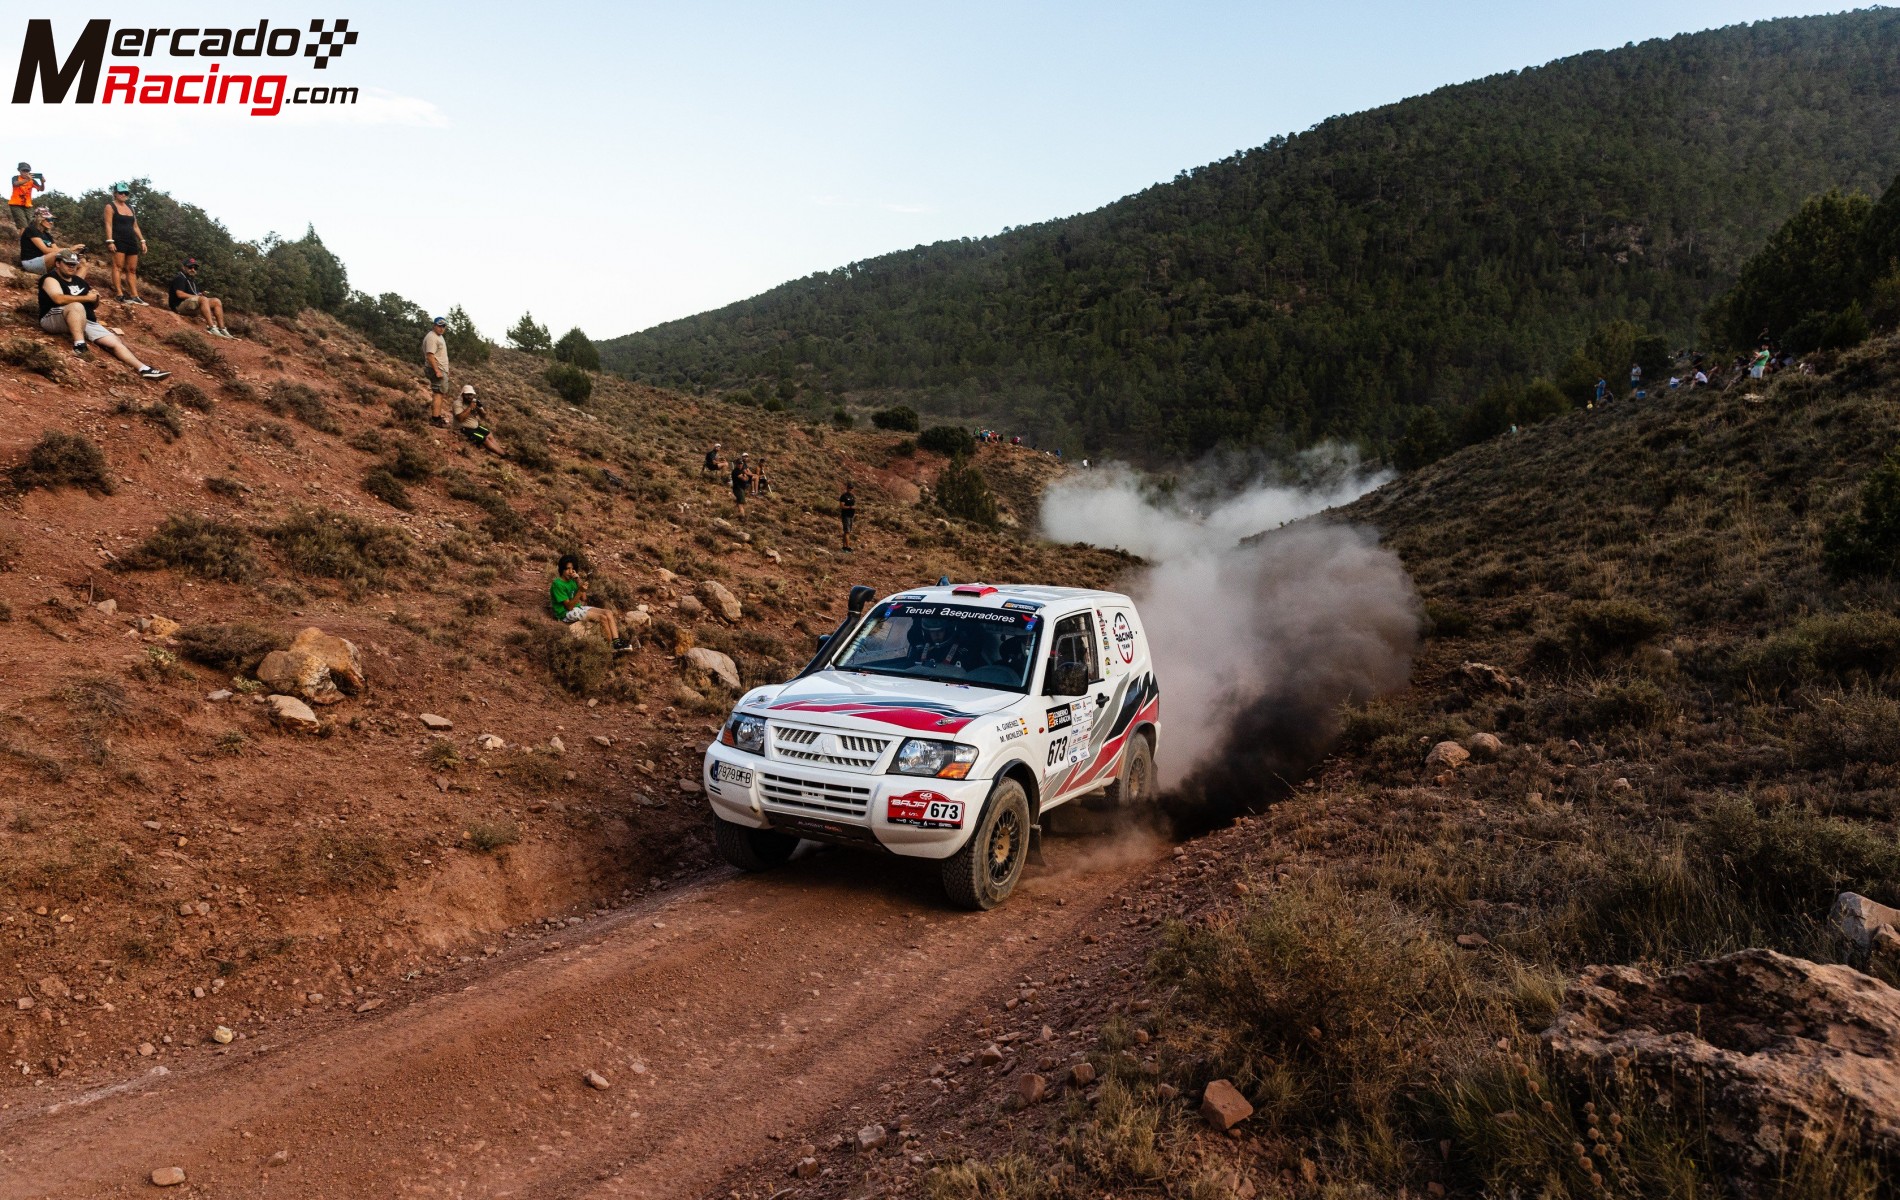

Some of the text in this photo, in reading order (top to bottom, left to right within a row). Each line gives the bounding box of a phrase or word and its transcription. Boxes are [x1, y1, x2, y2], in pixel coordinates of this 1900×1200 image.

[905, 606, 1016, 623] Teruel aseguradores
[1115, 631, 1134, 642] RACING
[1047, 736, 1068, 767] 673
[891, 799, 927, 808] BAJA
[930, 802, 959, 819] 673
